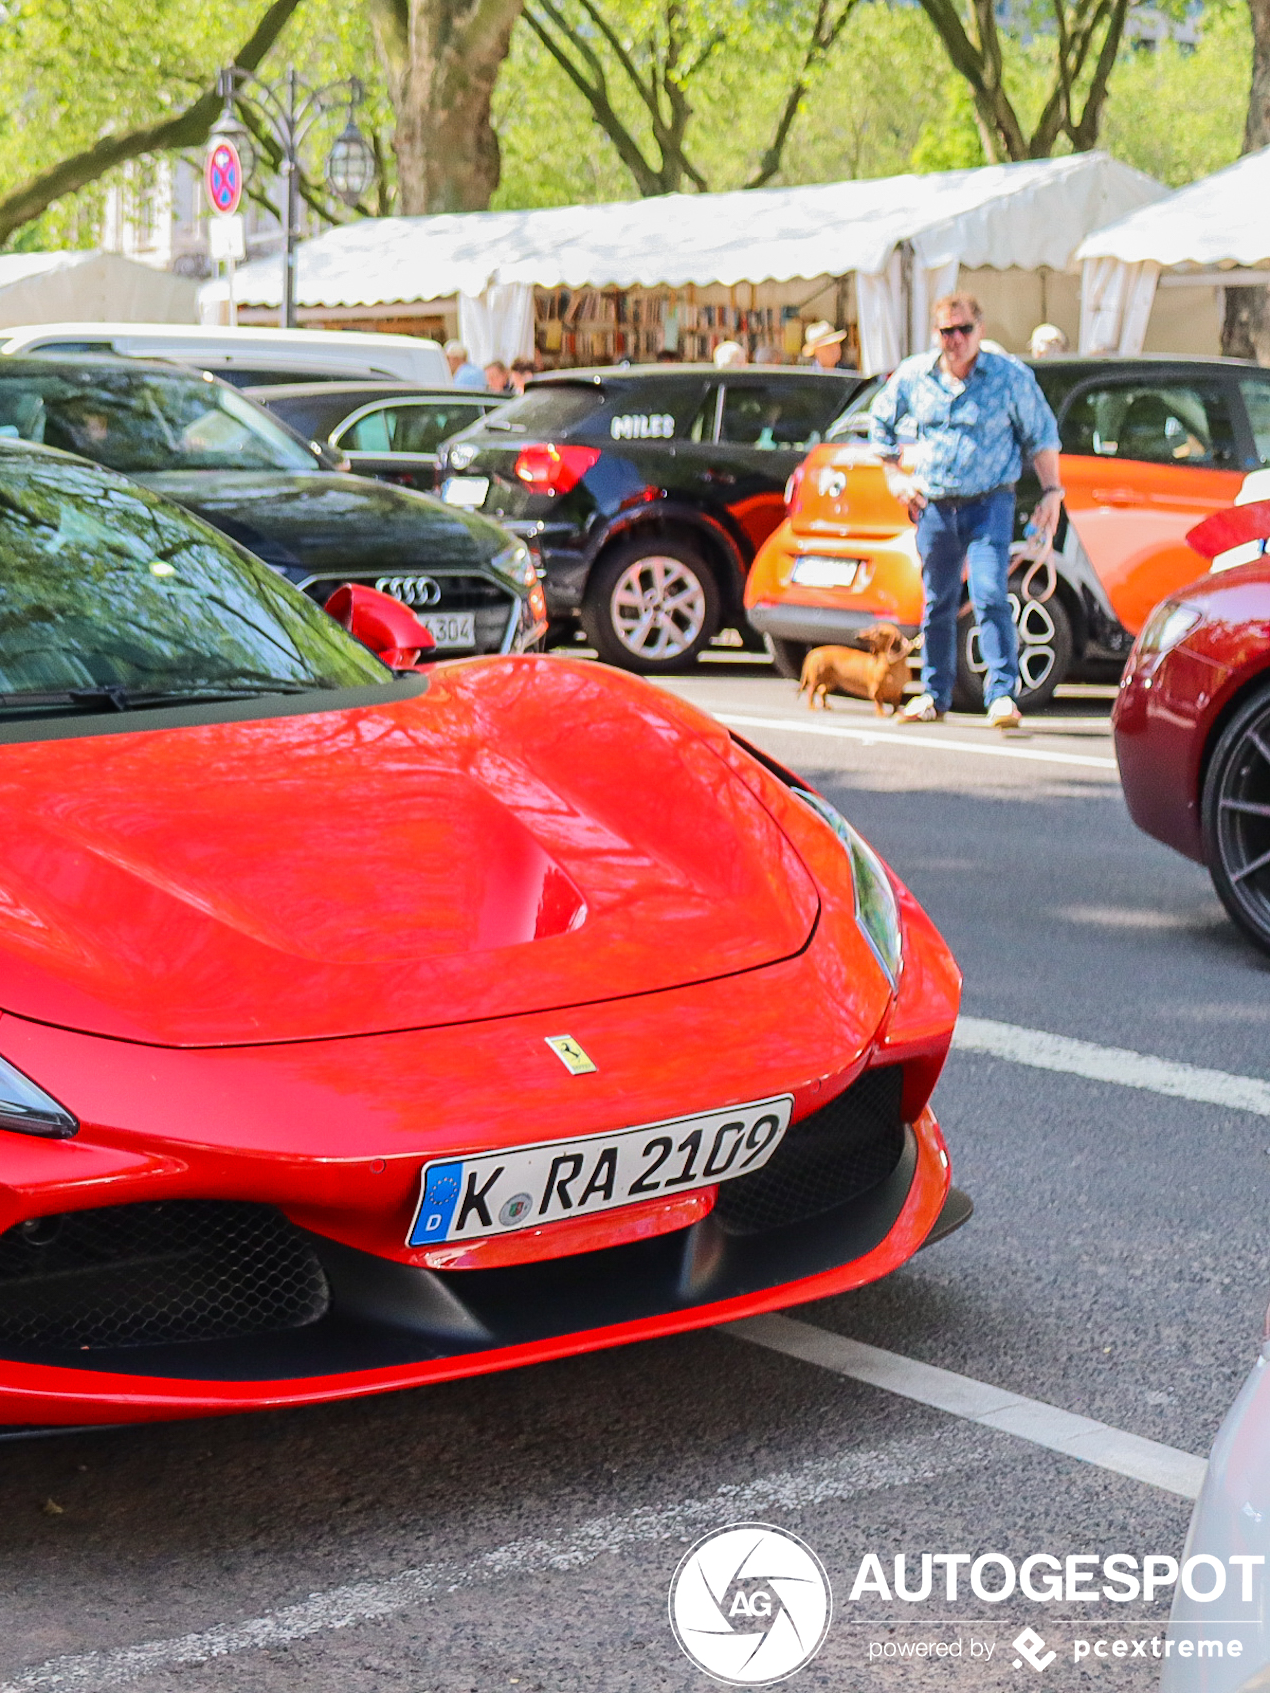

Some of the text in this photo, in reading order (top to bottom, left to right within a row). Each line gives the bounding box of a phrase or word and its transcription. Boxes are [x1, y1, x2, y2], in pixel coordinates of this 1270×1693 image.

[455, 1113, 781, 1231] K RA 2109
[425, 1213, 442, 1232] D
